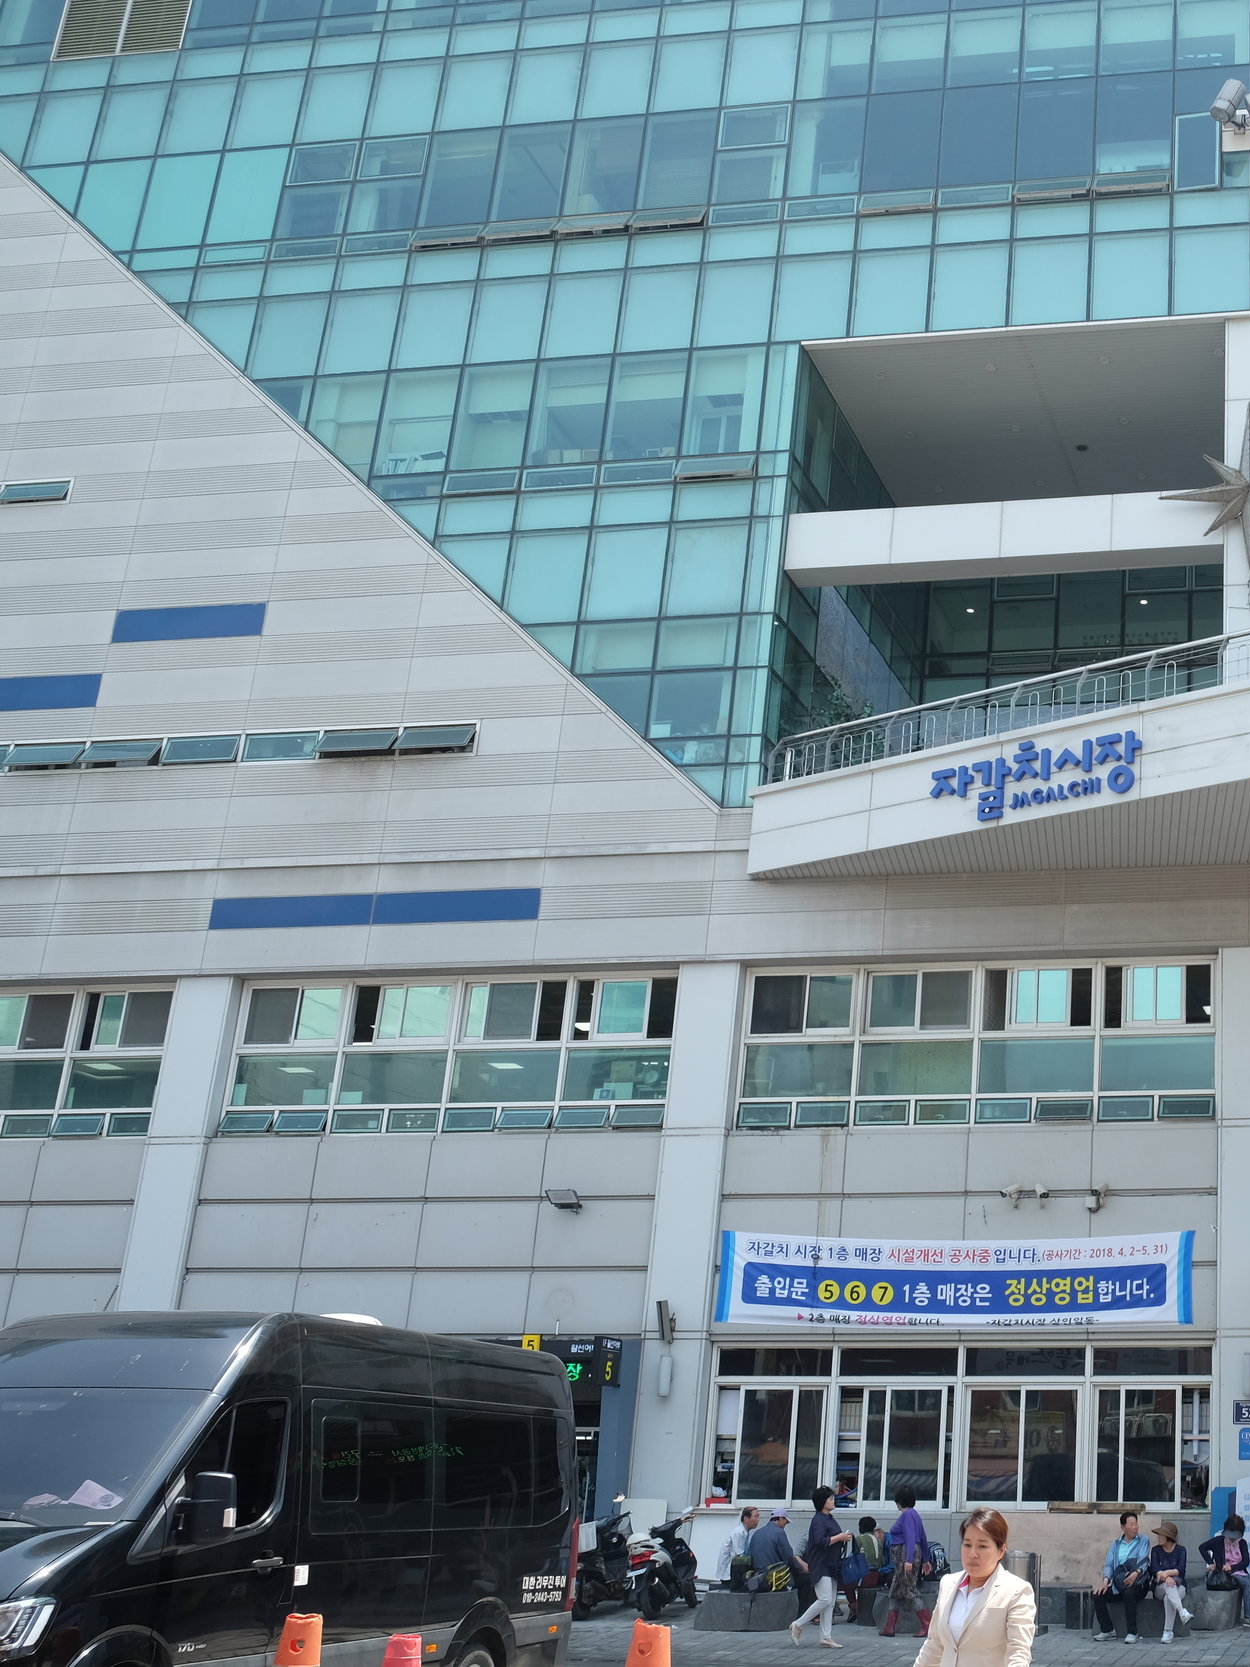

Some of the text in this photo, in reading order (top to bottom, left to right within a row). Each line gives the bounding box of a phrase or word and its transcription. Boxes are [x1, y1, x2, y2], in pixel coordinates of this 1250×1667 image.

[929, 730, 1143, 822] 자갈치시장
[1009, 776, 1102, 810] JAGALCHI
[748, 1241, 789, 1258] 자갈치
[794, 1244, 822, 1260] 시장
[828, 1247, 849, 1261] 1층
[855, 1247, 882, 1262] 매장
[888, 1248, 943, 1264] 시설개선
[948, 1248, 1041, 1264] 공사중입니다.
[1090, 1248, 1115, 1258] 2018.
[1154, 1243, 1168, 1255] 31)
[754, 1274, 809, 1300] 출입문
[903, 1283, 931, 1306] 1층
[937, 1283, 992, 1307] 매장은
[1004, 1275, 1155, 1306] 정상영업합니다.
[808, 1313, 825, 1324] 2층
[829, 1314, 850, 1325] 매장
[527, 1339, 535, 1351] 5
[605, 1361, 613, 1381] 5
[522, 1575, 567, 1590] 대한 리무진 투어
